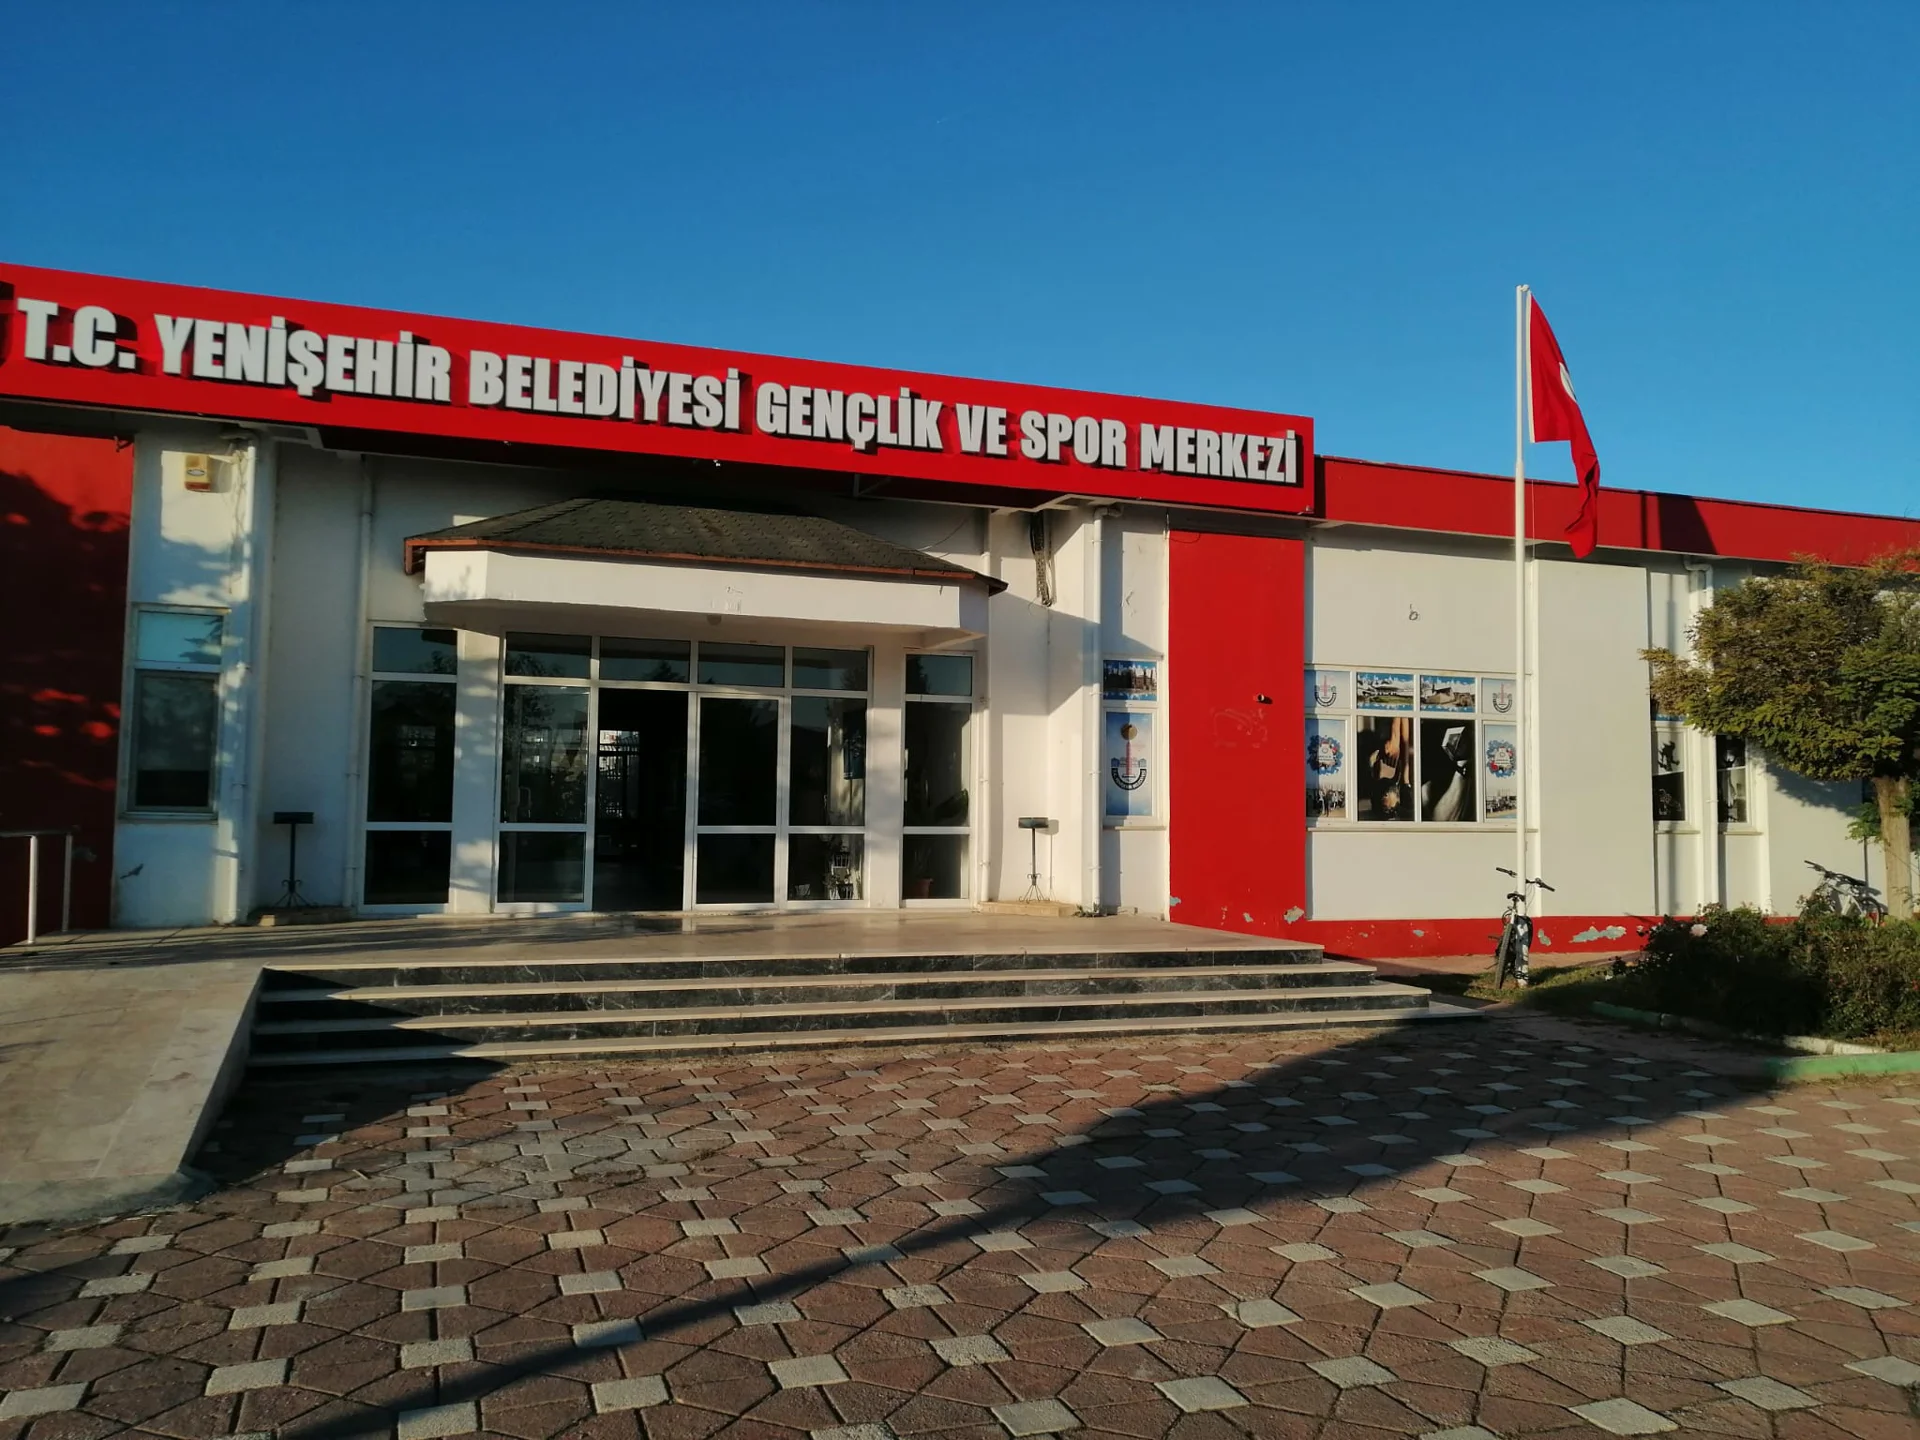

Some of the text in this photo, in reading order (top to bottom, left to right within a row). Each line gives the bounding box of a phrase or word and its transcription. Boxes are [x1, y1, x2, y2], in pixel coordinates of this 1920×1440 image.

[17, 298, 1297, 484] T.C. YENİŞEHİR BELEDİYESİ GENÇLİK VE SPOR MERKEZİ
